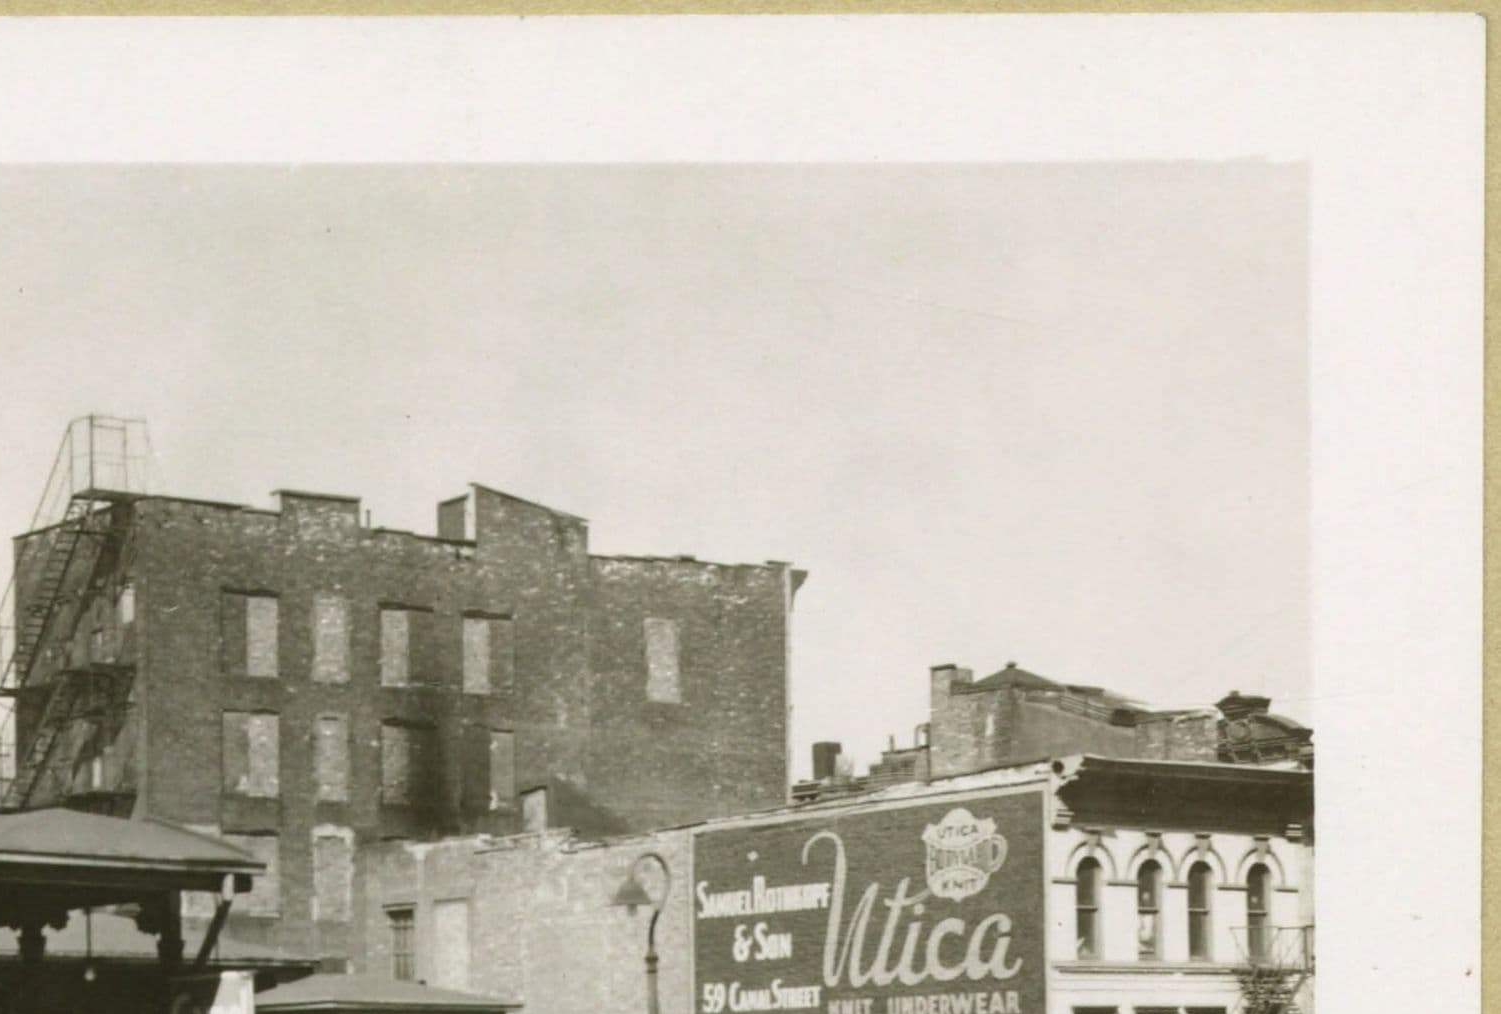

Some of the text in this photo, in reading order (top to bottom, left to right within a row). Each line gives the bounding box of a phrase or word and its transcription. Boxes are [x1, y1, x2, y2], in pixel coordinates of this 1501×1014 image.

[936, 824, 979, 840] UTICA
[942, 878, 979, 890] KNIT
[802, 831, 1023, 989] Utica
[732, 924, 752, 963] &
[702, 982, 727, 1014] 59
